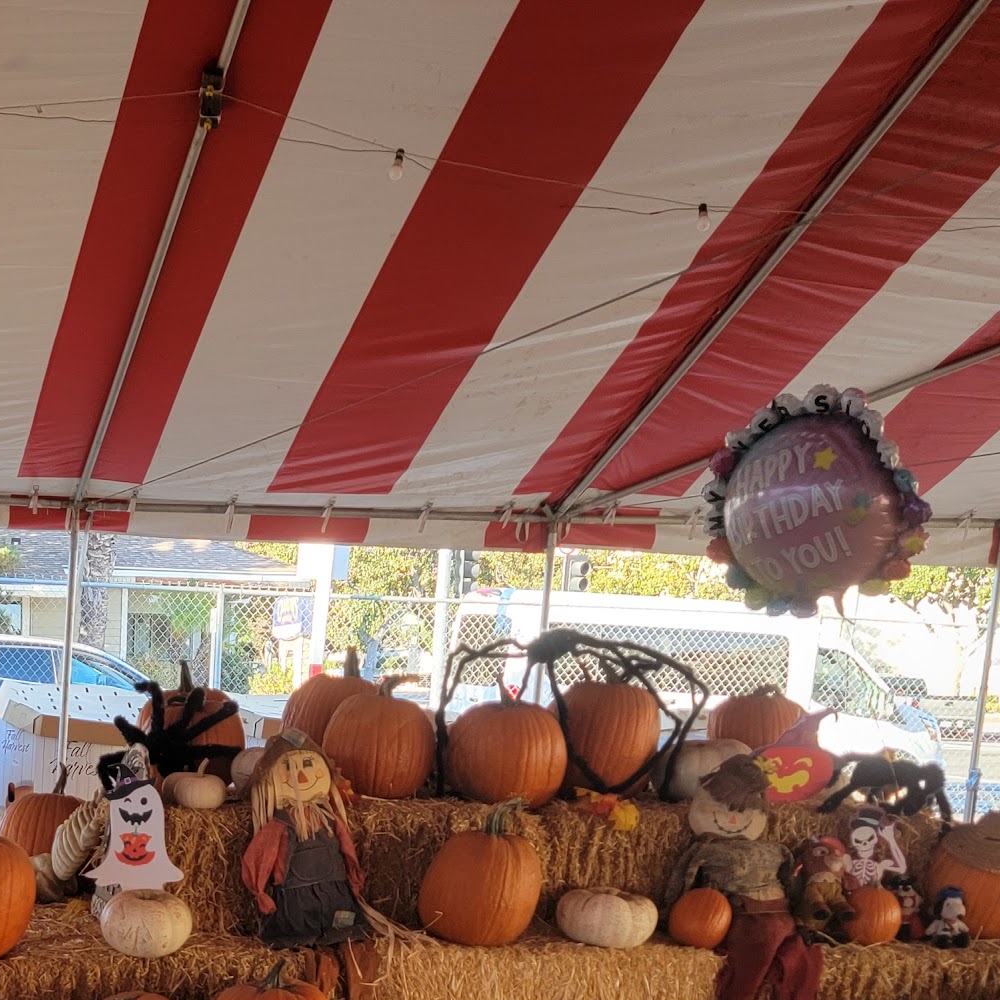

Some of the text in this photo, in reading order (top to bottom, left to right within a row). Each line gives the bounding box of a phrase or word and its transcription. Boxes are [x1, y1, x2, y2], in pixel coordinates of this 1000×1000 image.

[735, 442, 811, 494] HAPPY
[782, 526, 852, 574] YOU!
[1, 739, 30, 754] Harvest
[6, 729, 24, 740] Fall
